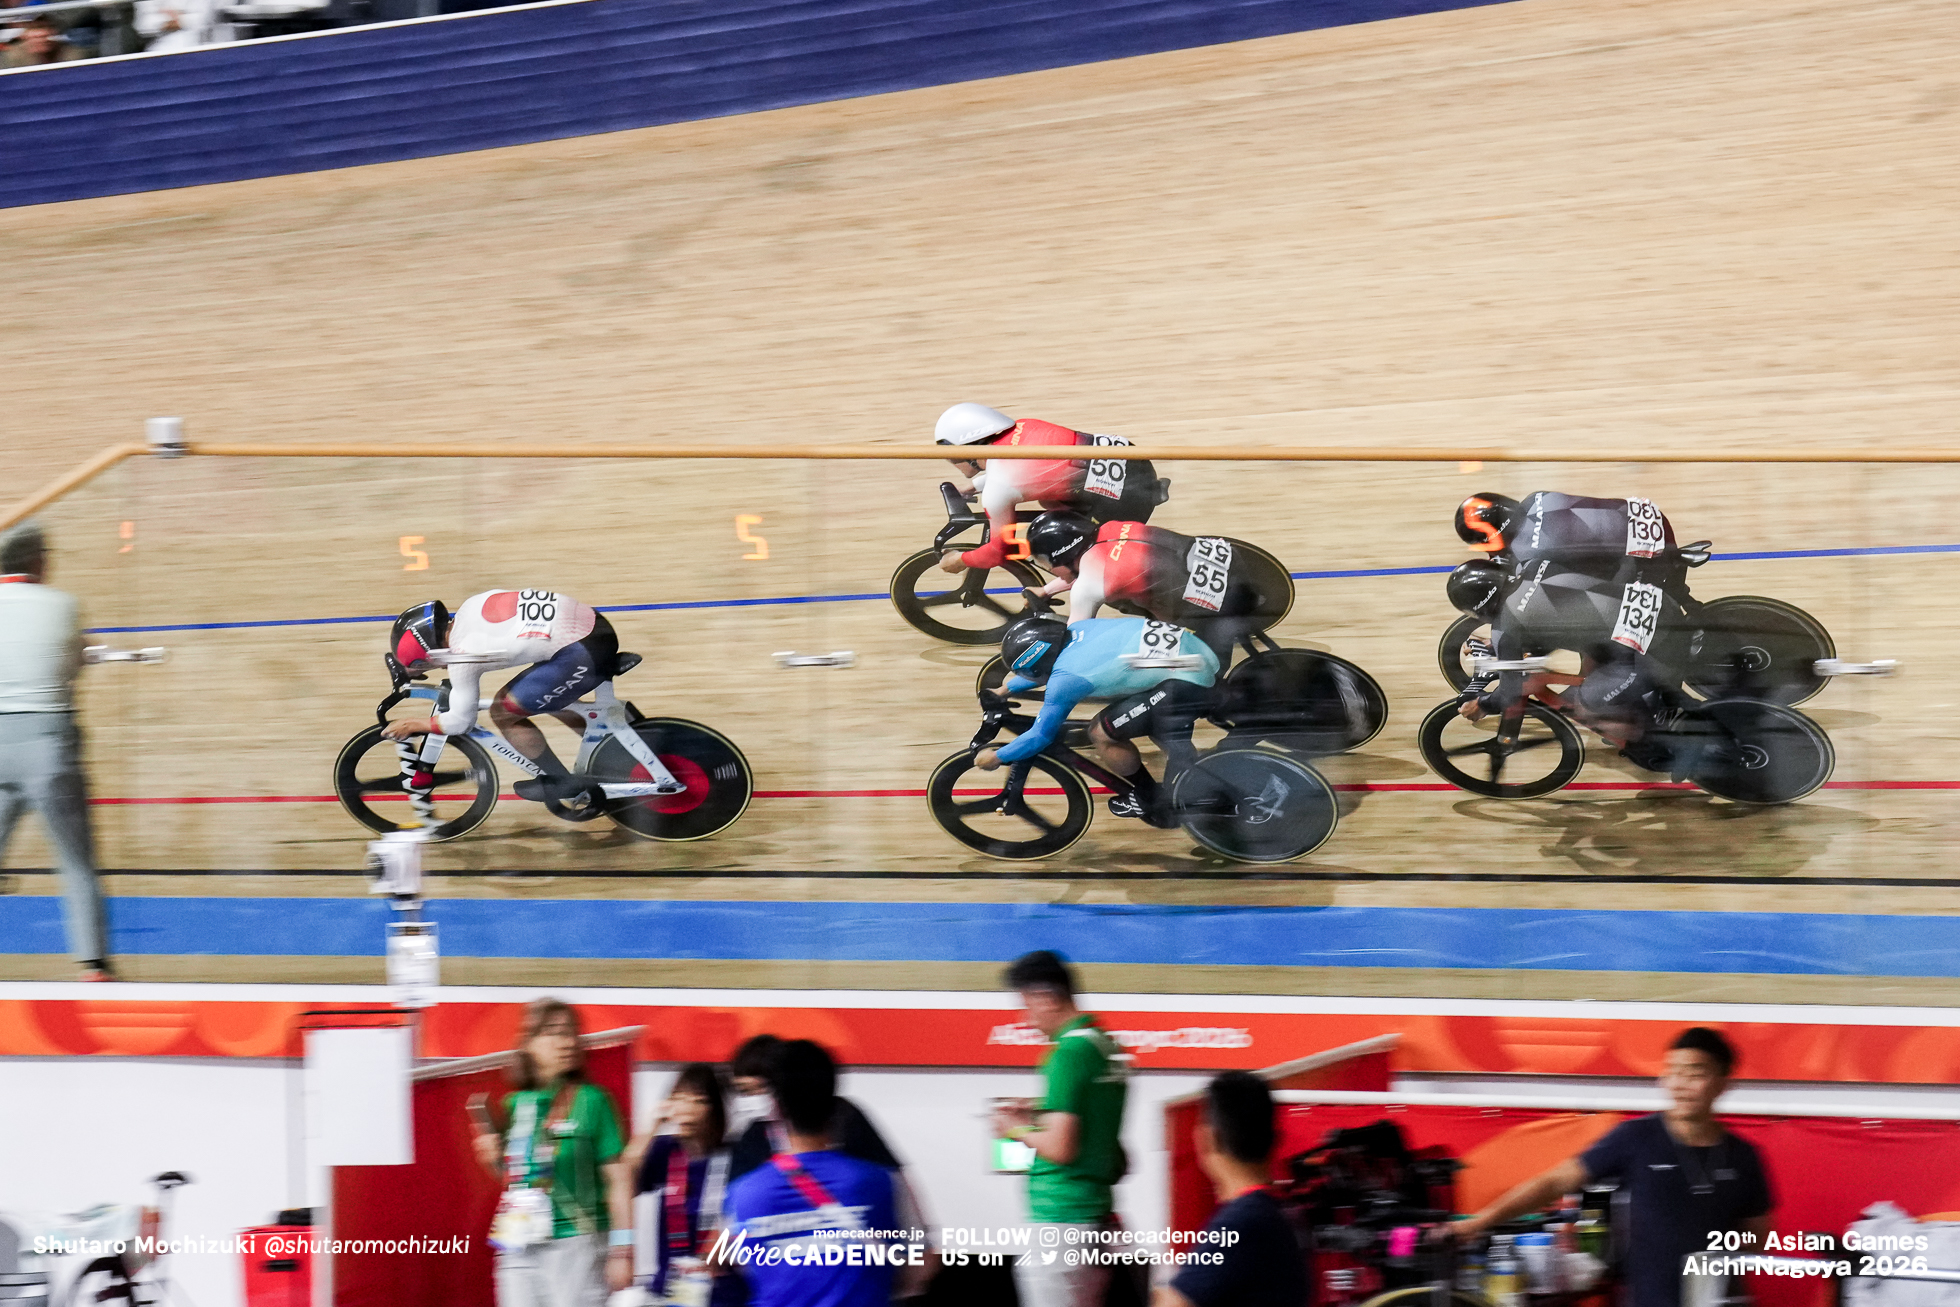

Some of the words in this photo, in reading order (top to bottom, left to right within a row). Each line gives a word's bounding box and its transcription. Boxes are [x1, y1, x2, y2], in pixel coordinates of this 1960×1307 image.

[1110, 523, 1133, 562] CHINA
[1628, 519, 1663, 542] 130
[1192, 564, 1225, 593] 55
[1517, 560, 1550, 612] MALAYSIA
[518, 602, 556, 622] 100
[1622, 605, 1655, 636] 134
[1143, 628, 1179, 650] 69
[536, 665, 589, 710] JAPAN
[491, 742, 543, 775] TORAYCA
